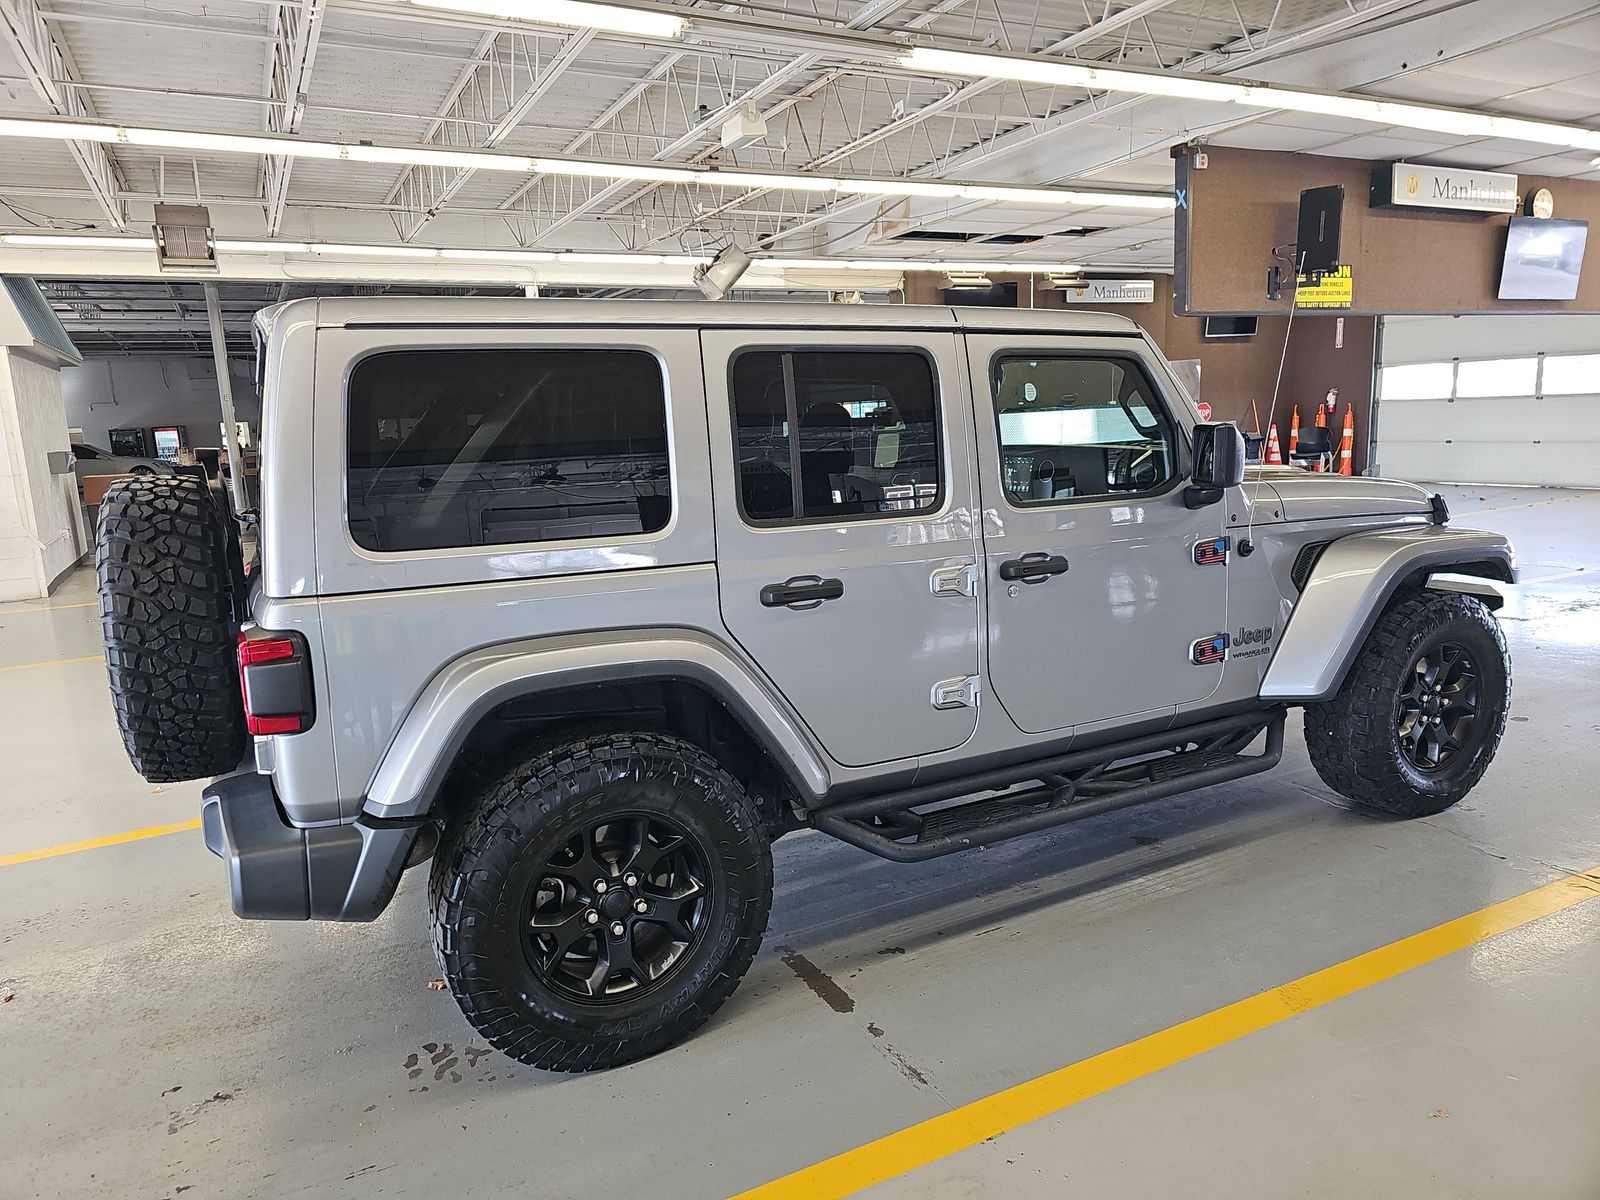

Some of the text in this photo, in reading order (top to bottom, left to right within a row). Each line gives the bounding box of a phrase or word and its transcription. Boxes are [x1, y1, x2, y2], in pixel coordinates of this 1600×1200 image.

[1432, 177, 1507, 203] Manheim
[1093, 285, 1146, 299] Manheim
[1232, 626, 1272, 647] Jeep
[1232, 646, 1270, 658] WRANGLER
